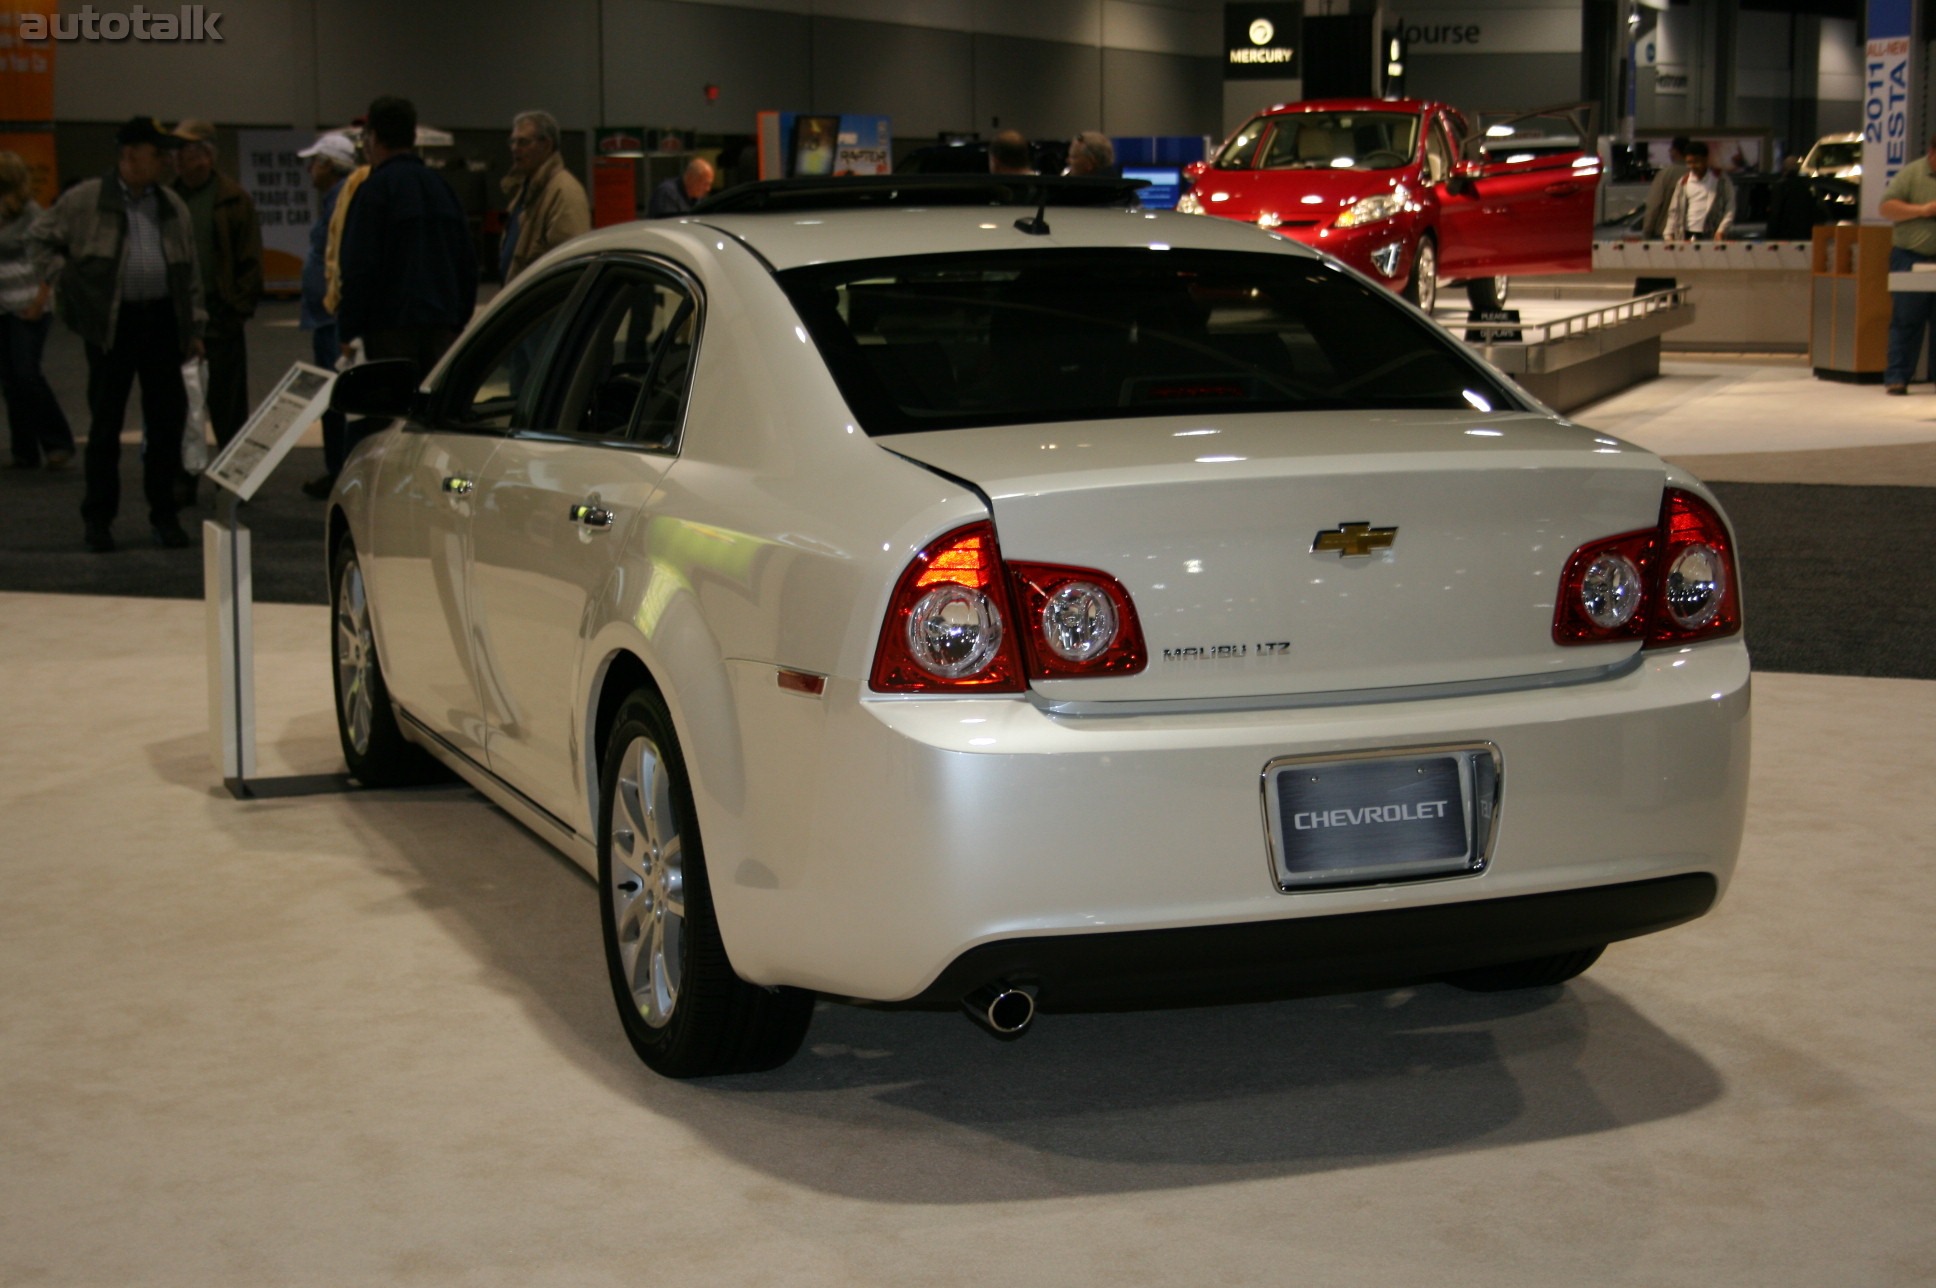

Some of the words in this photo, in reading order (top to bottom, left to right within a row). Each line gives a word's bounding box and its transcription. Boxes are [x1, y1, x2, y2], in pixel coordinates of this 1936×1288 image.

[1230, 48, 1293, 64] MERCURY
[1867, 40, 1909, 57] ALL-NEW
[1866, 61, 1884, 144] 2011
[1886, 60, 1907, 187] IESTA
[252, 152, 273, 168] THE
[257, 172, 281, 186] WAY
[286, 172, 301, 186] TO
[256, 209, 282, 225] OUR
[287, 209, 311, 225] CAR
[1481, 312, 1508, 320] PLEASE
[1480, 328, 1513, 338] DPLAYS
[1163, 644, 1246, 661] MALIBU
[1256, 642, 1290, 656] LTZ
[1293, 800, 1448, 830] CHEVROLET
